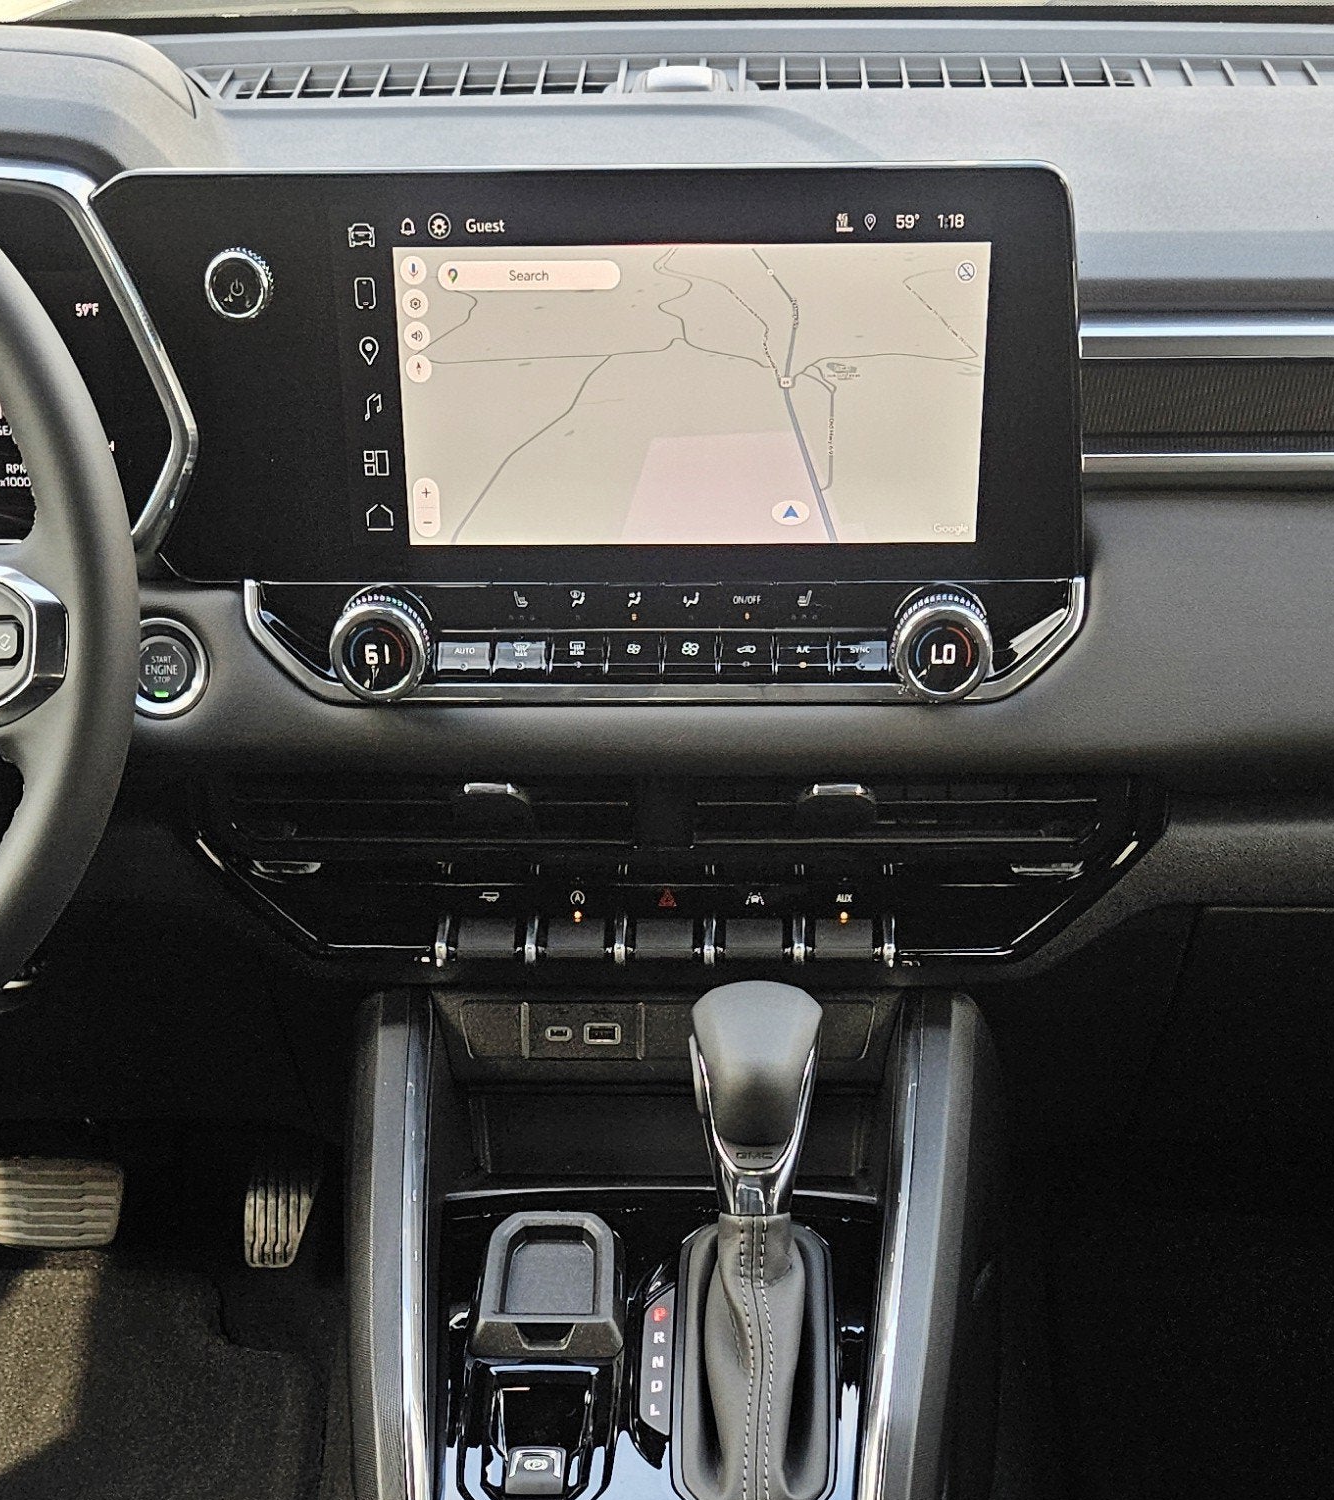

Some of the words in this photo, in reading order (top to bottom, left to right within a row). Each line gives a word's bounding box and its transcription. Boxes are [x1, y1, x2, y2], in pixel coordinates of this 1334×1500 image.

[465, 218, 505, 233] Guest
[937, 214, 965, 229] 1:18
[509, 270, 549, 283] Search
[933, 522, 968, 536] Google
[732, 595, 761, 605] ON/OFF
[454, 647, 475, 655] AUTO
[796, 645, 811, 654] A/C
[850, 646, 870, 655] SYNC
[931, 644, 956, 664] LO
[151, 655, 171, 664] START
[145, 664, 178, 675] ENGINE
[153, 676, 171, 684] STOP
[836, 893, 853, 903] AUX
[736, 1152, 773, 1160] GMC
[653, 1307, 667, 1322] P
[653, 1331, 665, 1344] R
[651, 1355, 664, 1369] N
[650, 1380, 663, 1393] D
[649, 1403, 661, 1416] L
